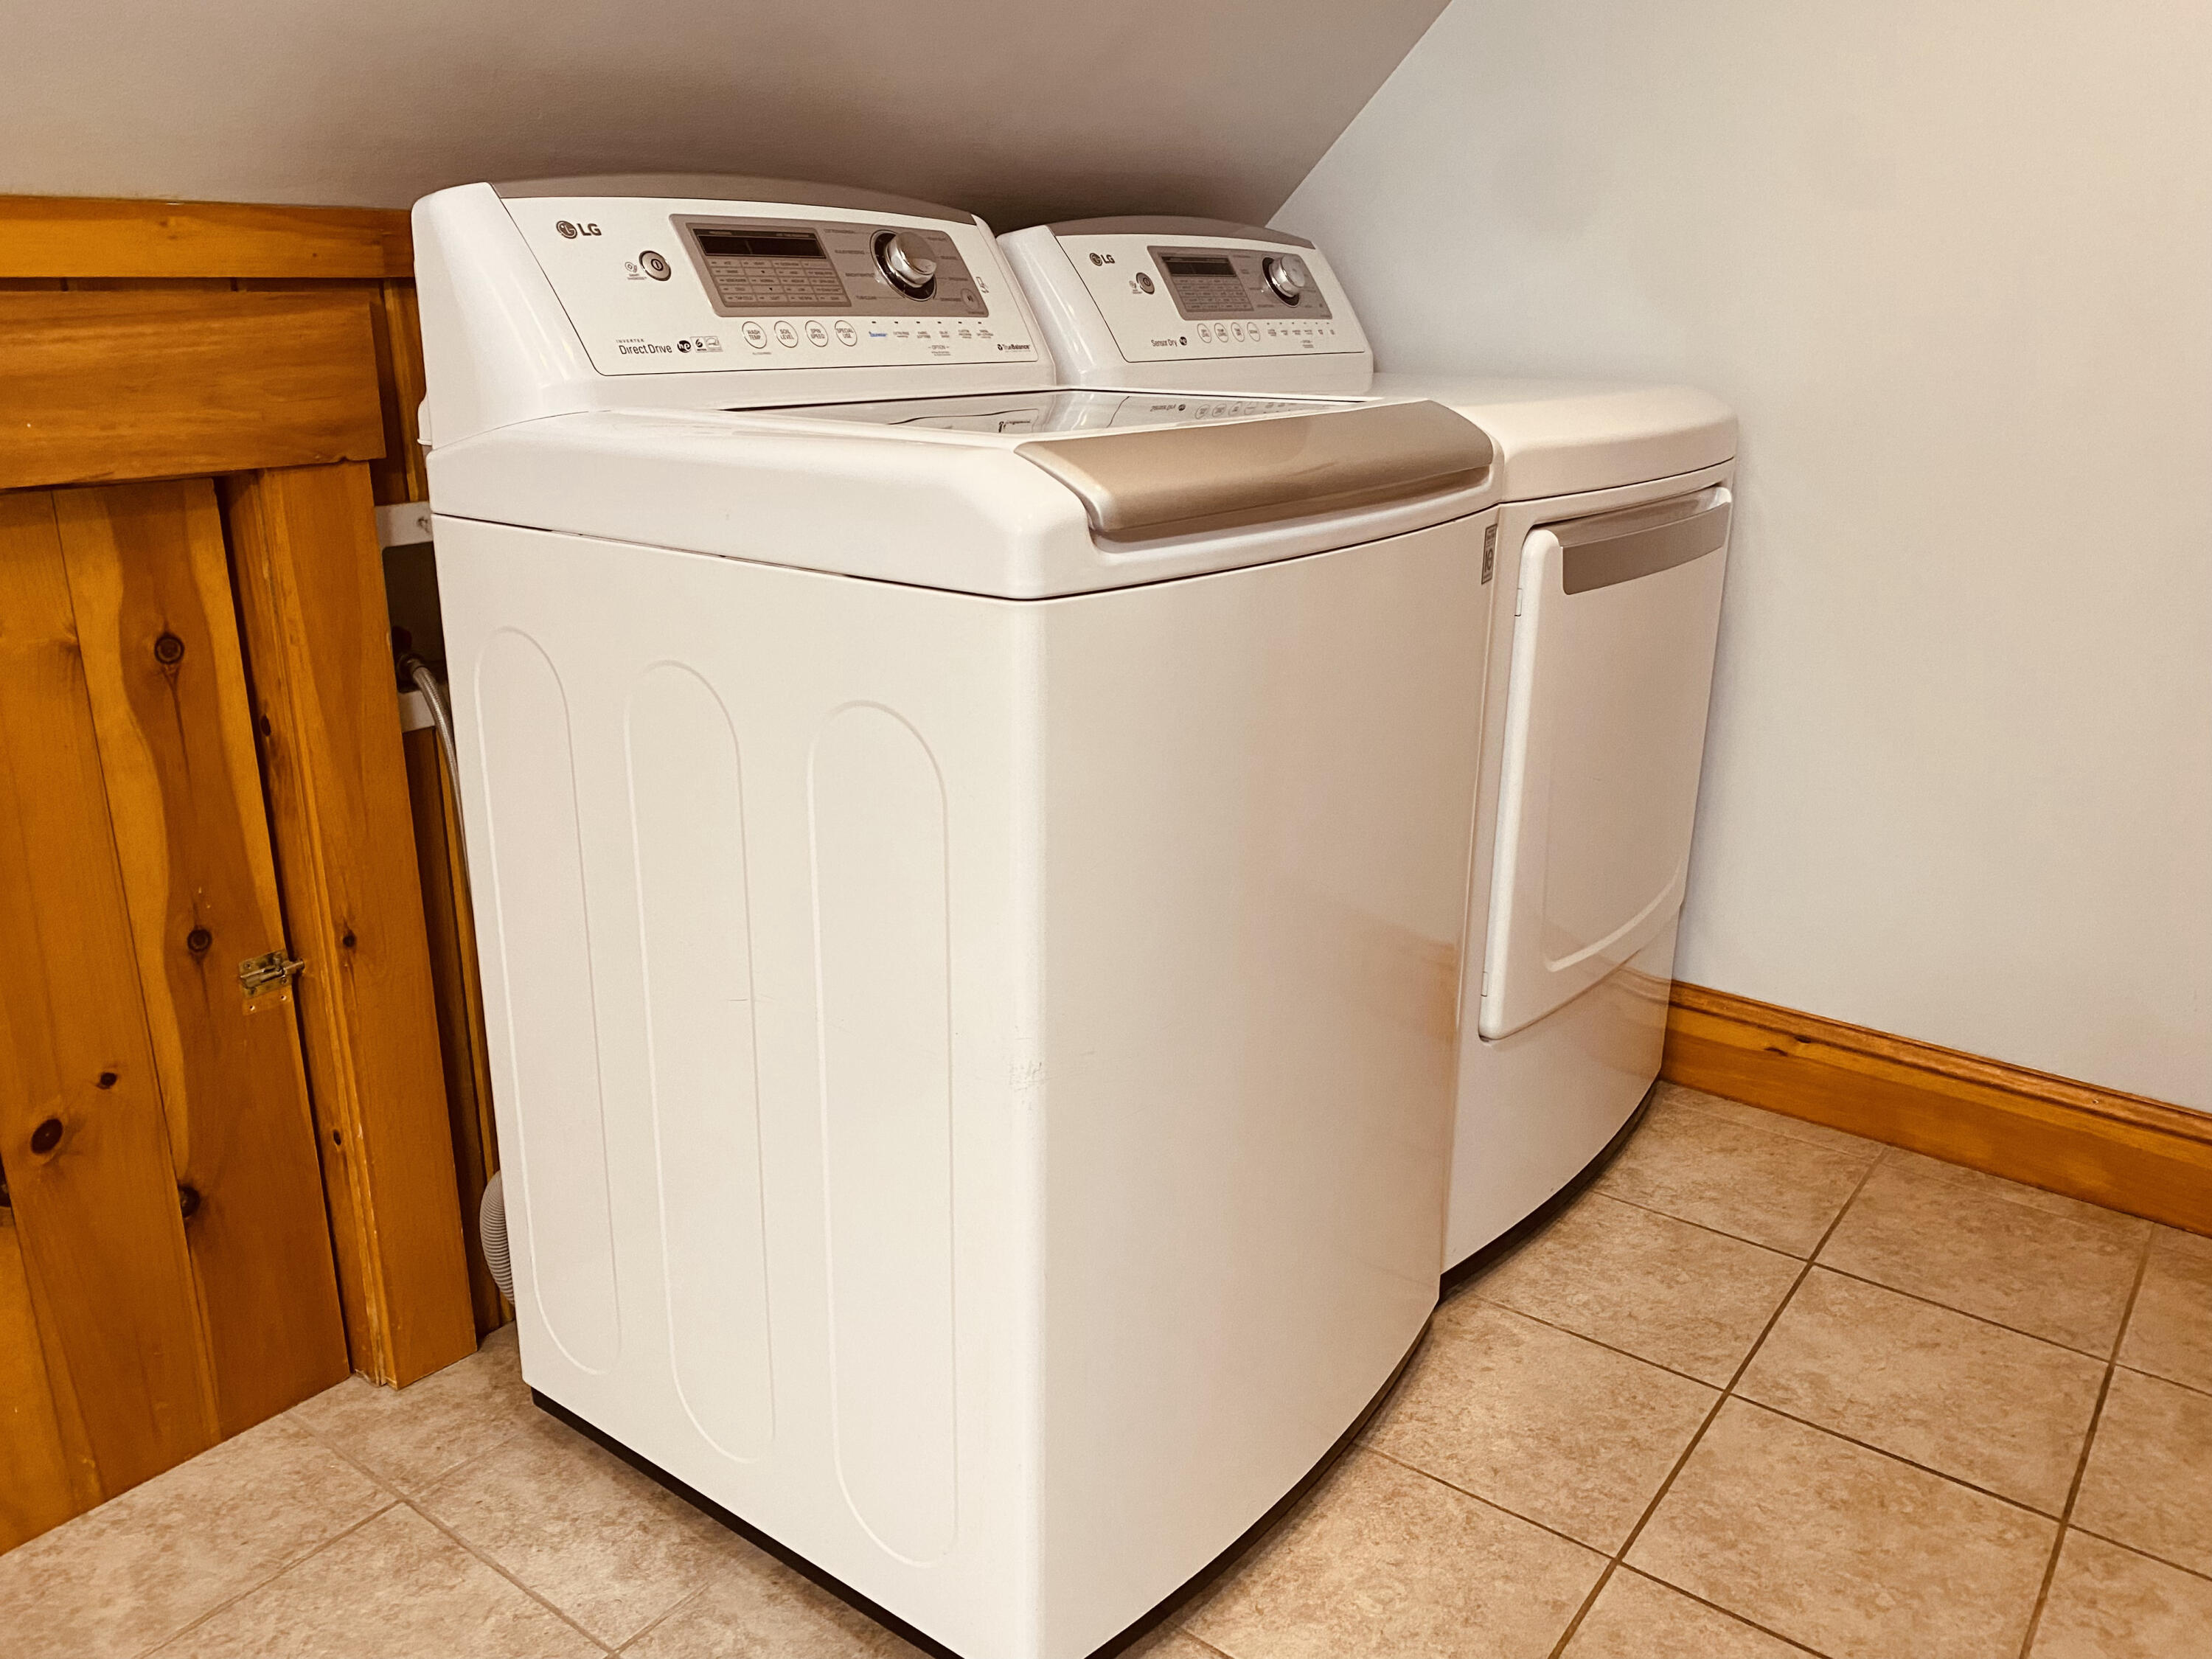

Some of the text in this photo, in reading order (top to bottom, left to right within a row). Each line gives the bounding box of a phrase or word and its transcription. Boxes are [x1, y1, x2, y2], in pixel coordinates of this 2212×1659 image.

[577, 223, 602, 236] LG
[1167, 338, 1177, 347] Dry
[619, 344, 672, 355] Direct Drive
